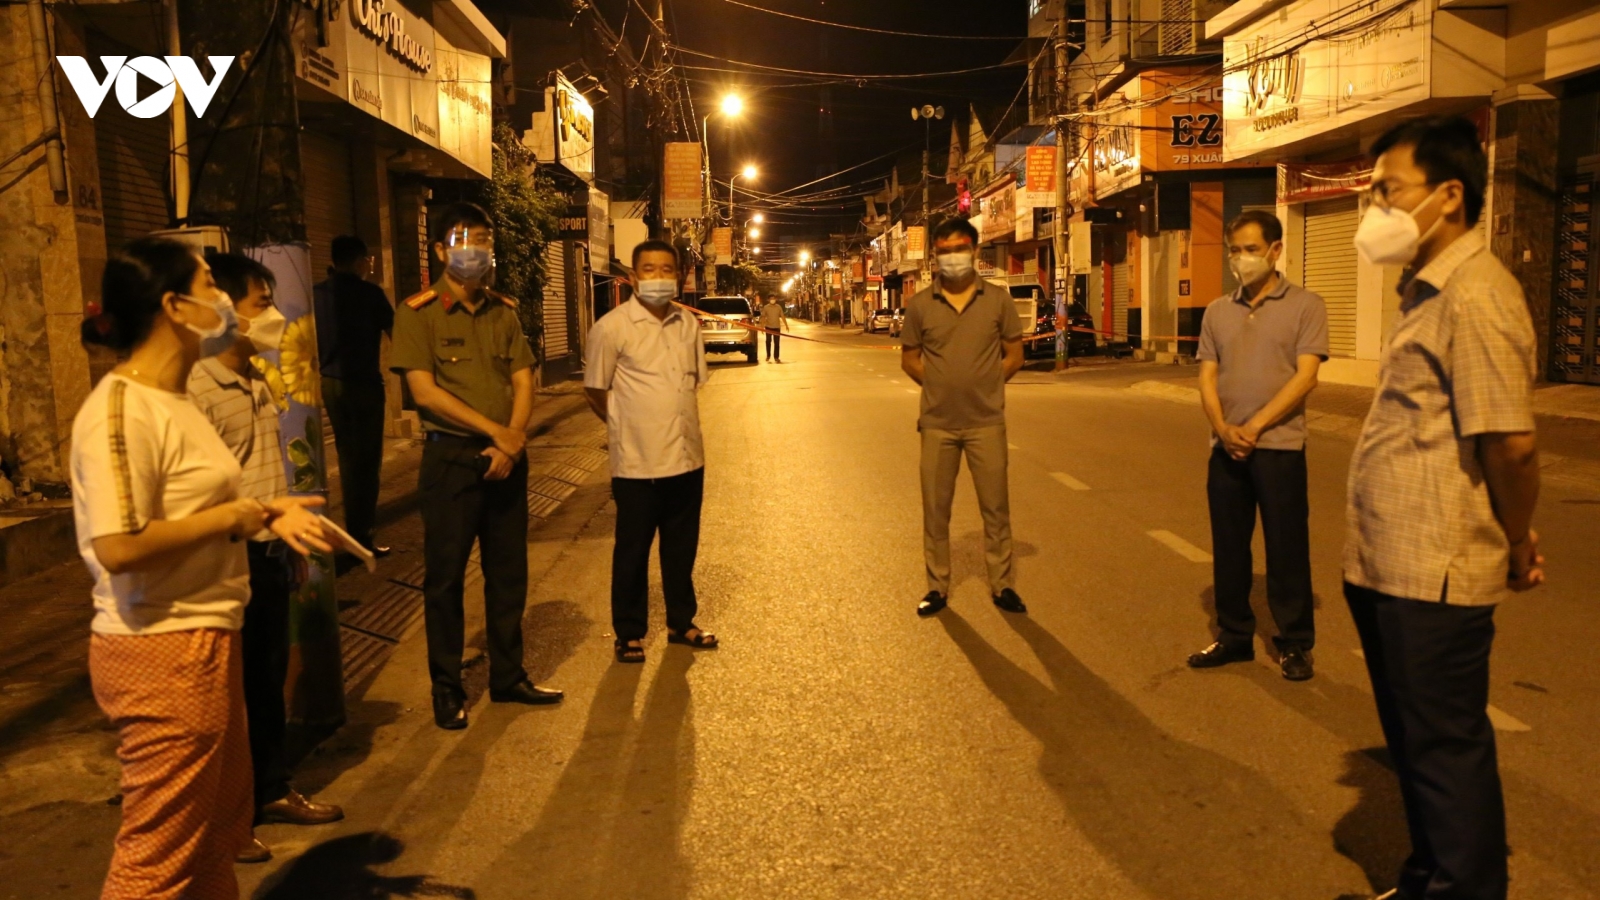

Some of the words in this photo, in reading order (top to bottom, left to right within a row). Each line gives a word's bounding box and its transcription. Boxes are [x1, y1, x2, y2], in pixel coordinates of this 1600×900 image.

[390, 11, 433, 74] House
[1170, 113, 1221, 147] EZ
[1172, 154, 1190, 164] 79
[560, 217, 587, 231] SPORT
